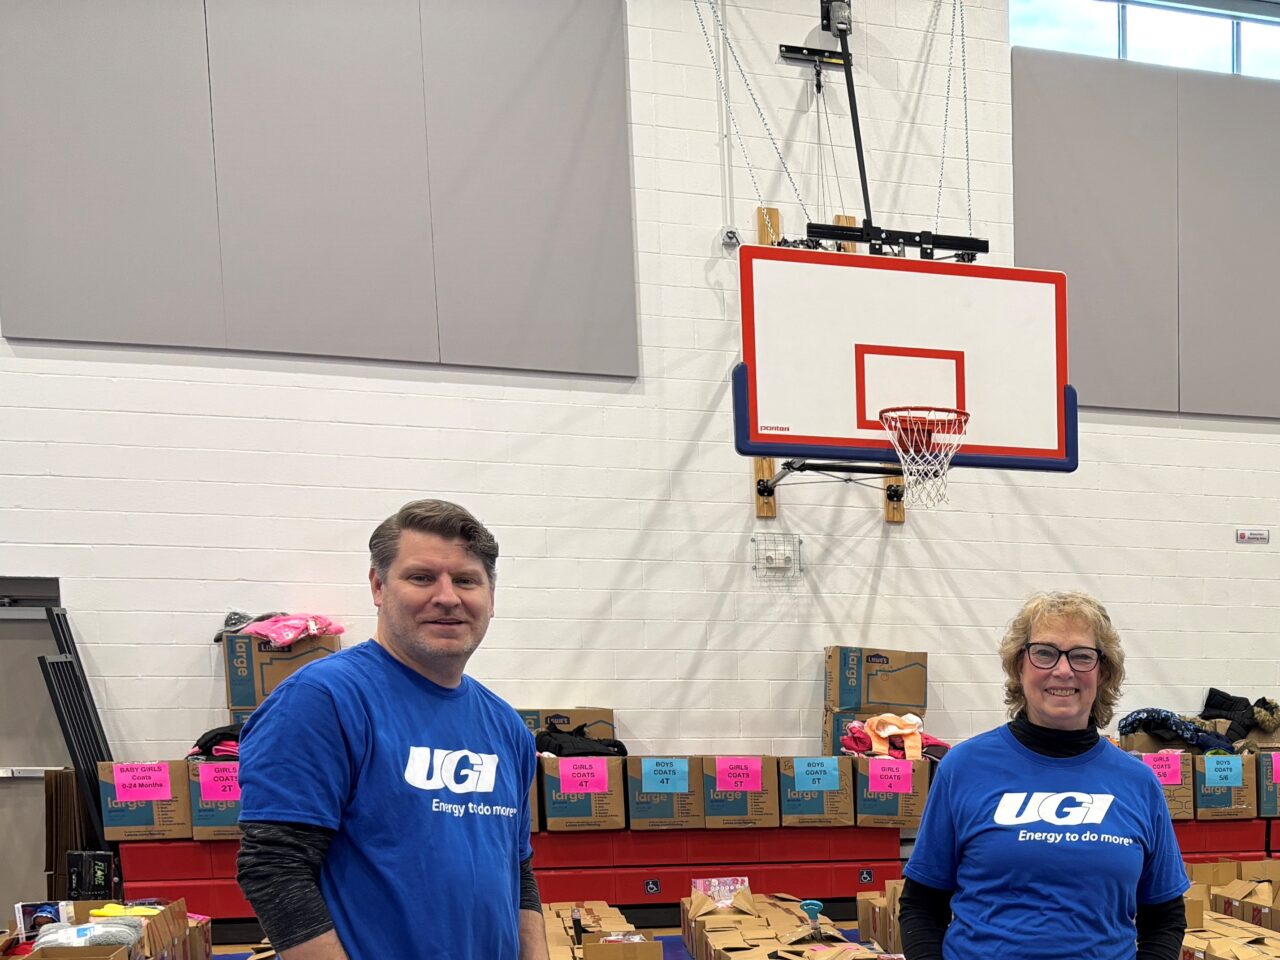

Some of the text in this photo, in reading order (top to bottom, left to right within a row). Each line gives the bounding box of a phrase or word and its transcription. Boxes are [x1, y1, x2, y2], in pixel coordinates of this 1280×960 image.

[233, 639, 249, 676] large
[845, 650, 861, 687] large
[404, 746, 499, 794] UGI
[578, 780, 589, 788] 4T
[1201, 785, 1227, 795] large
[552, 790, 585, 803] large
[635, 791, 667, 803] large
[710, 789, 742, 801] large
[787, 788, 818, 800] large
[863, 788, 894, 801] large
[107, 797, 146, 811] large
[199, 798, 236, 811] large
[432, 799, 465, 817] Energy
[478, 802, 491, 815] do
[993, 791, 1115, 826] UGI
[1018, 830, 1063, 844] Energy
[1065, 833, 1079, 842] to
[1081, 831, 1098, 842] do
[94, 861, 105, 886] FLARE
